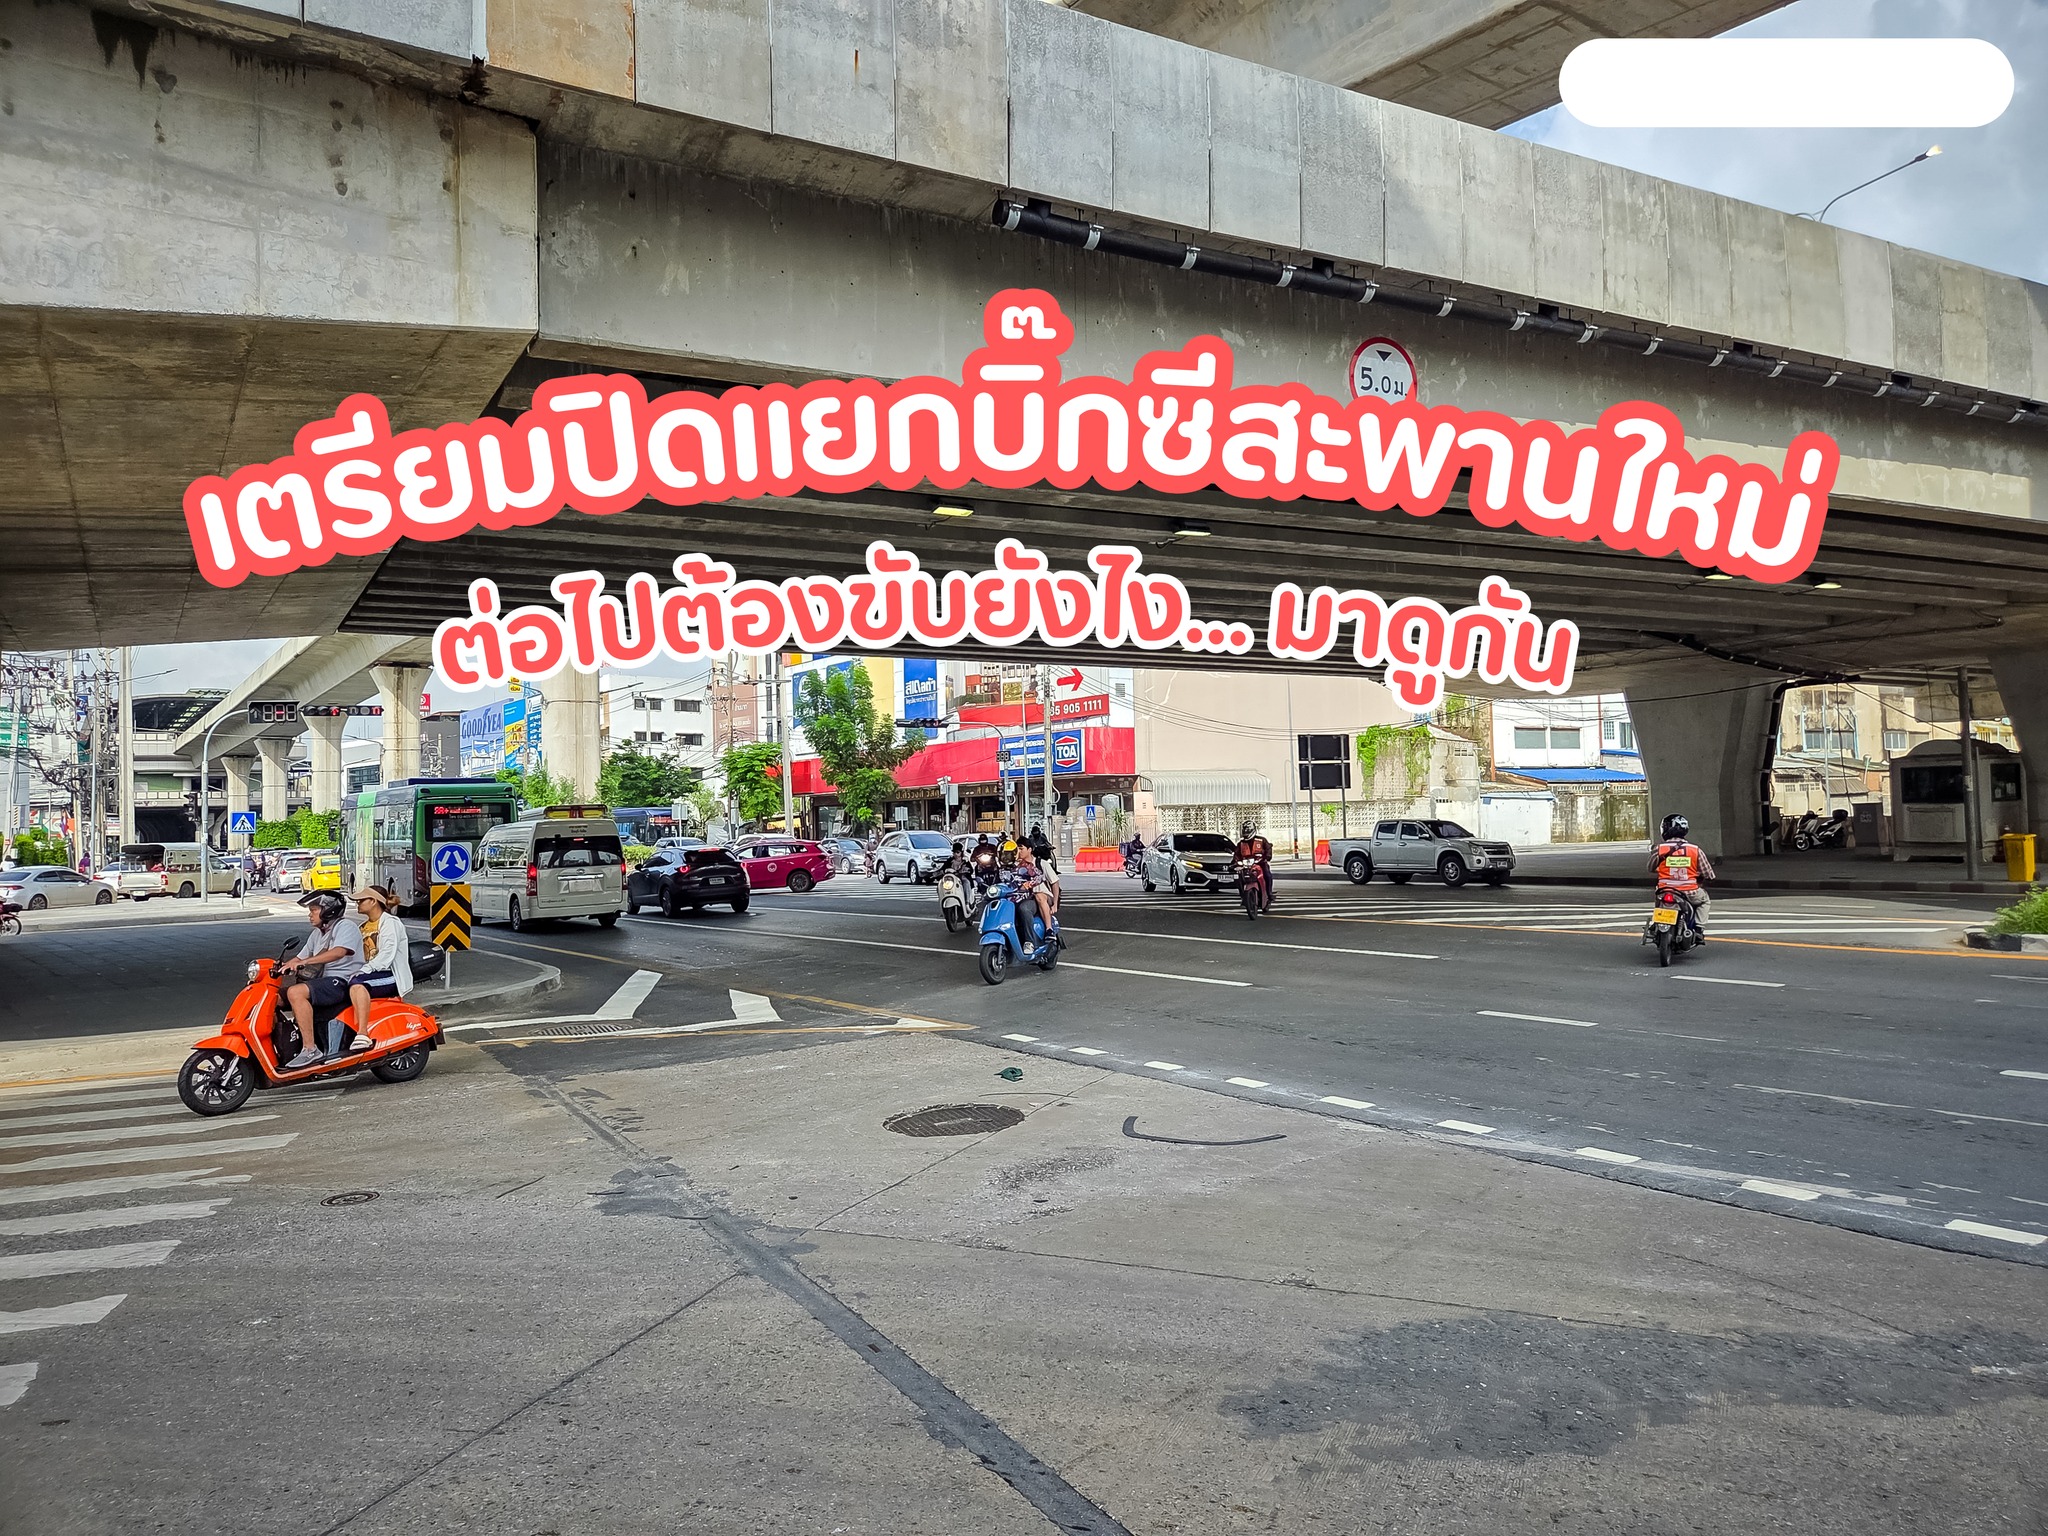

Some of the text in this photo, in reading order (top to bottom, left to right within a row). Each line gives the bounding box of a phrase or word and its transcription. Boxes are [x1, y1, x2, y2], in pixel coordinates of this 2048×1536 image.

[1063, 702, 1080, 714] 905
[1083, 699, 1102, 711] 1111
[462, 711, 503, 740] GOODYEA
[1057, 745, 1077, 758] TOA
